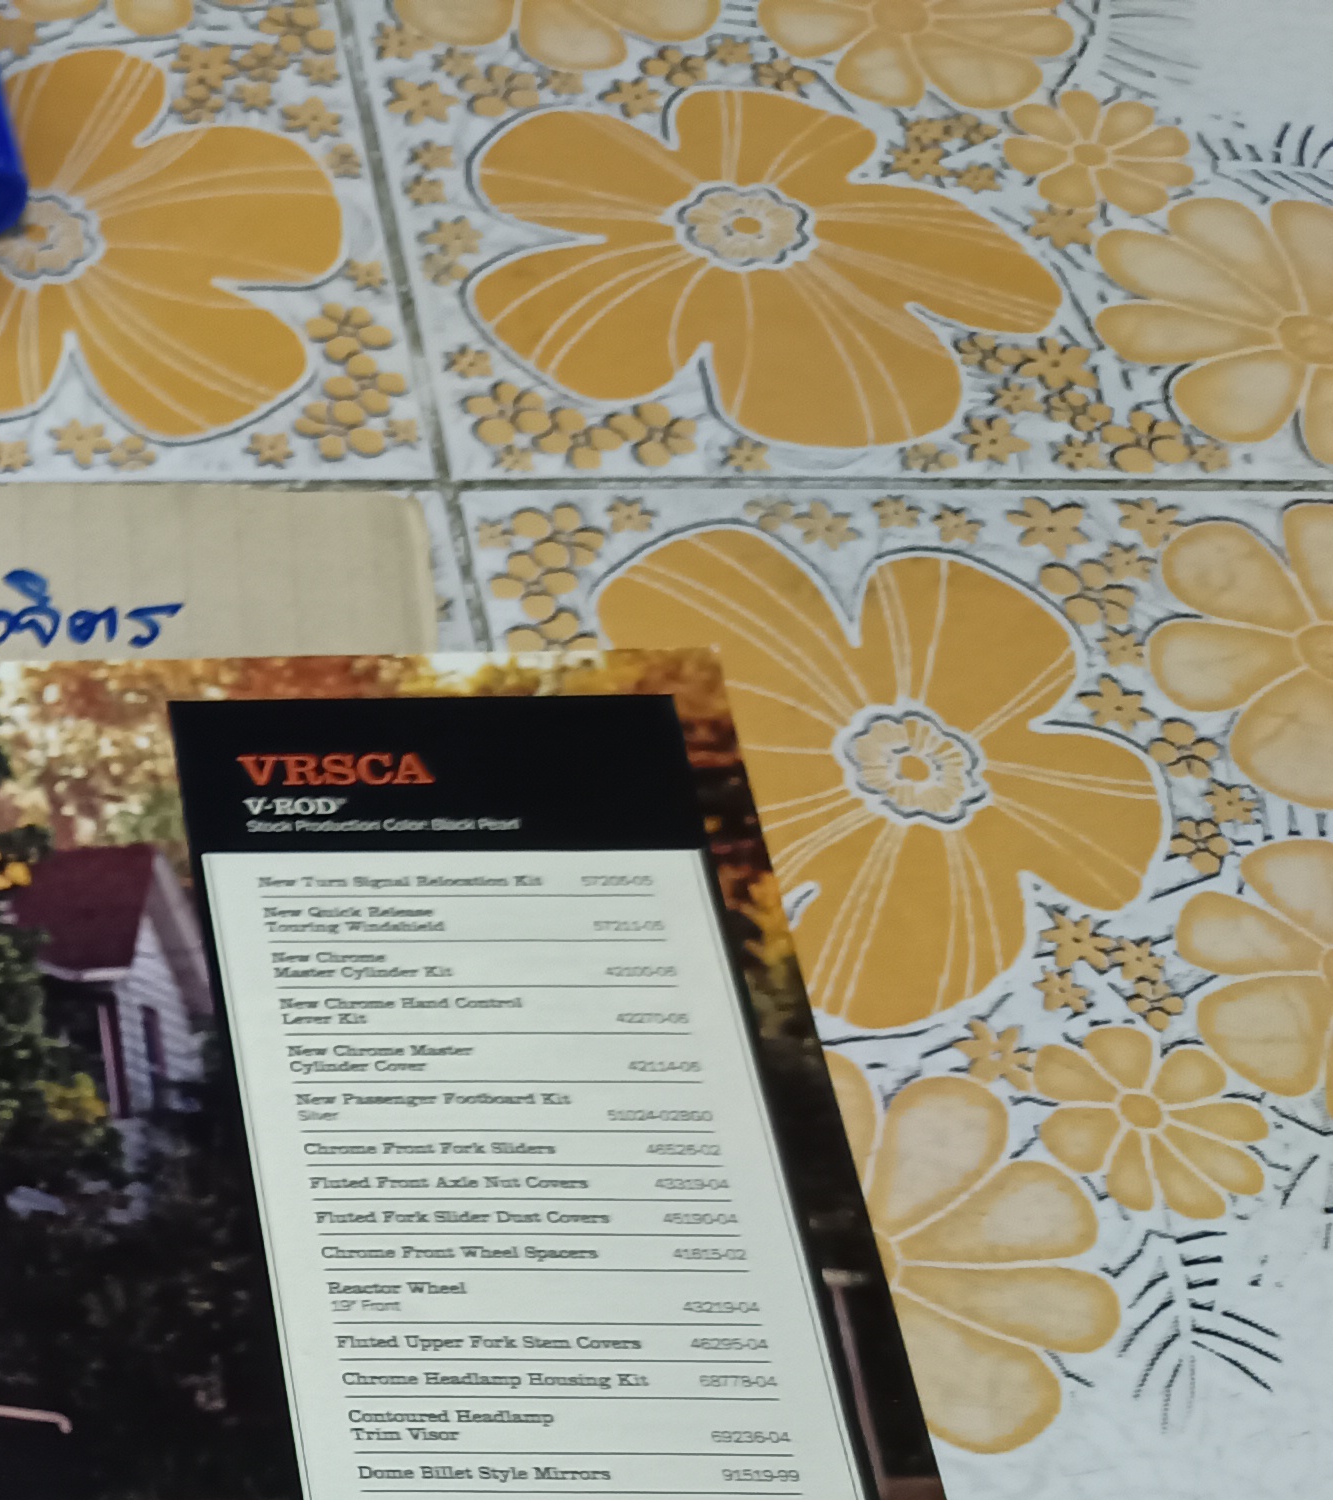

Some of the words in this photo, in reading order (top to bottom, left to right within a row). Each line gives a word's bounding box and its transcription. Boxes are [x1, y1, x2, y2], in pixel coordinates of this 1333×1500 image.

[236, 752, 436, 786] VRSCA
[350, 1428, 402, 1440] Trim
[408, 1428, 460, 1441] Visor
[357, 1466, 414, 1479] Dome
[419, 1466, 473, 1479] Billet
[478, 1466, 528, 1483] Style
[532, 1467, 611, 1480] Mirrors
